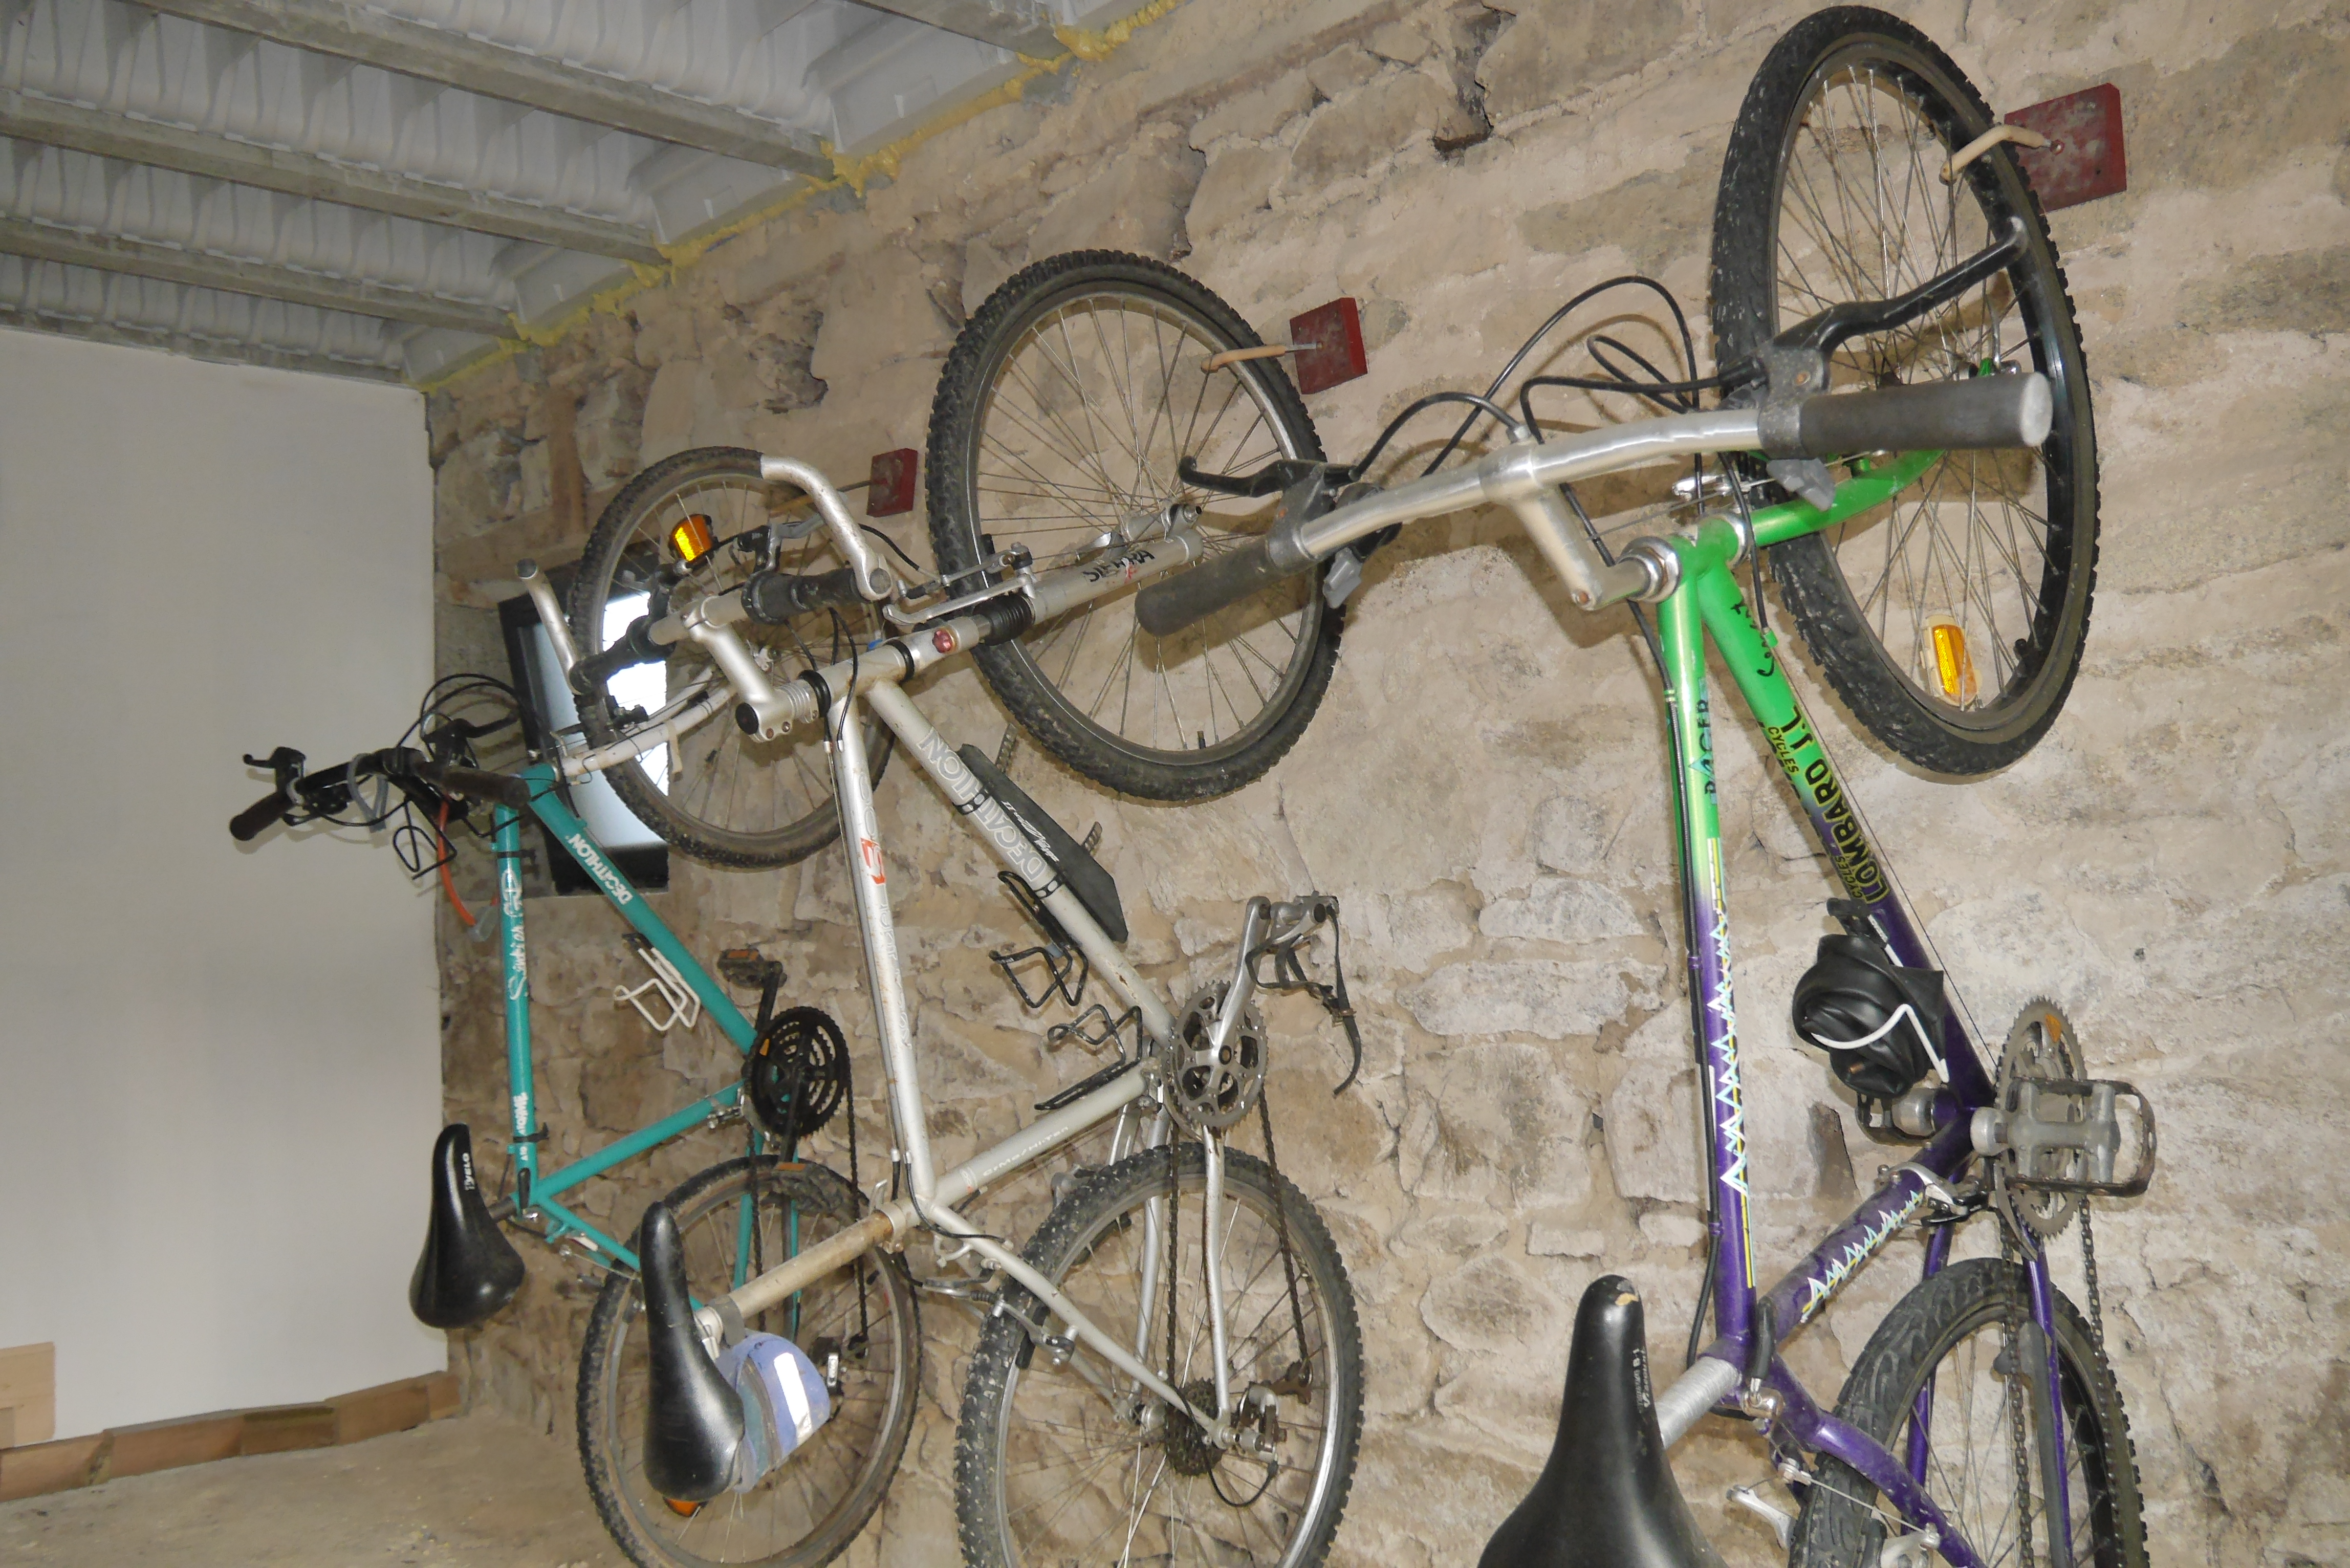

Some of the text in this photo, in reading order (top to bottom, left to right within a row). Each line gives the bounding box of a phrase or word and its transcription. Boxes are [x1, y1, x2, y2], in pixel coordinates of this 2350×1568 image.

[1768, 725, 1800, 774] CYCLES
[916, 730, 1047, 882] DECATHLON
[1805, 758, 1890, 904] LOMBARD
[568, 834, 634, 906] DECATHLON
[1836, 855, 1864, 899] CYCLES
